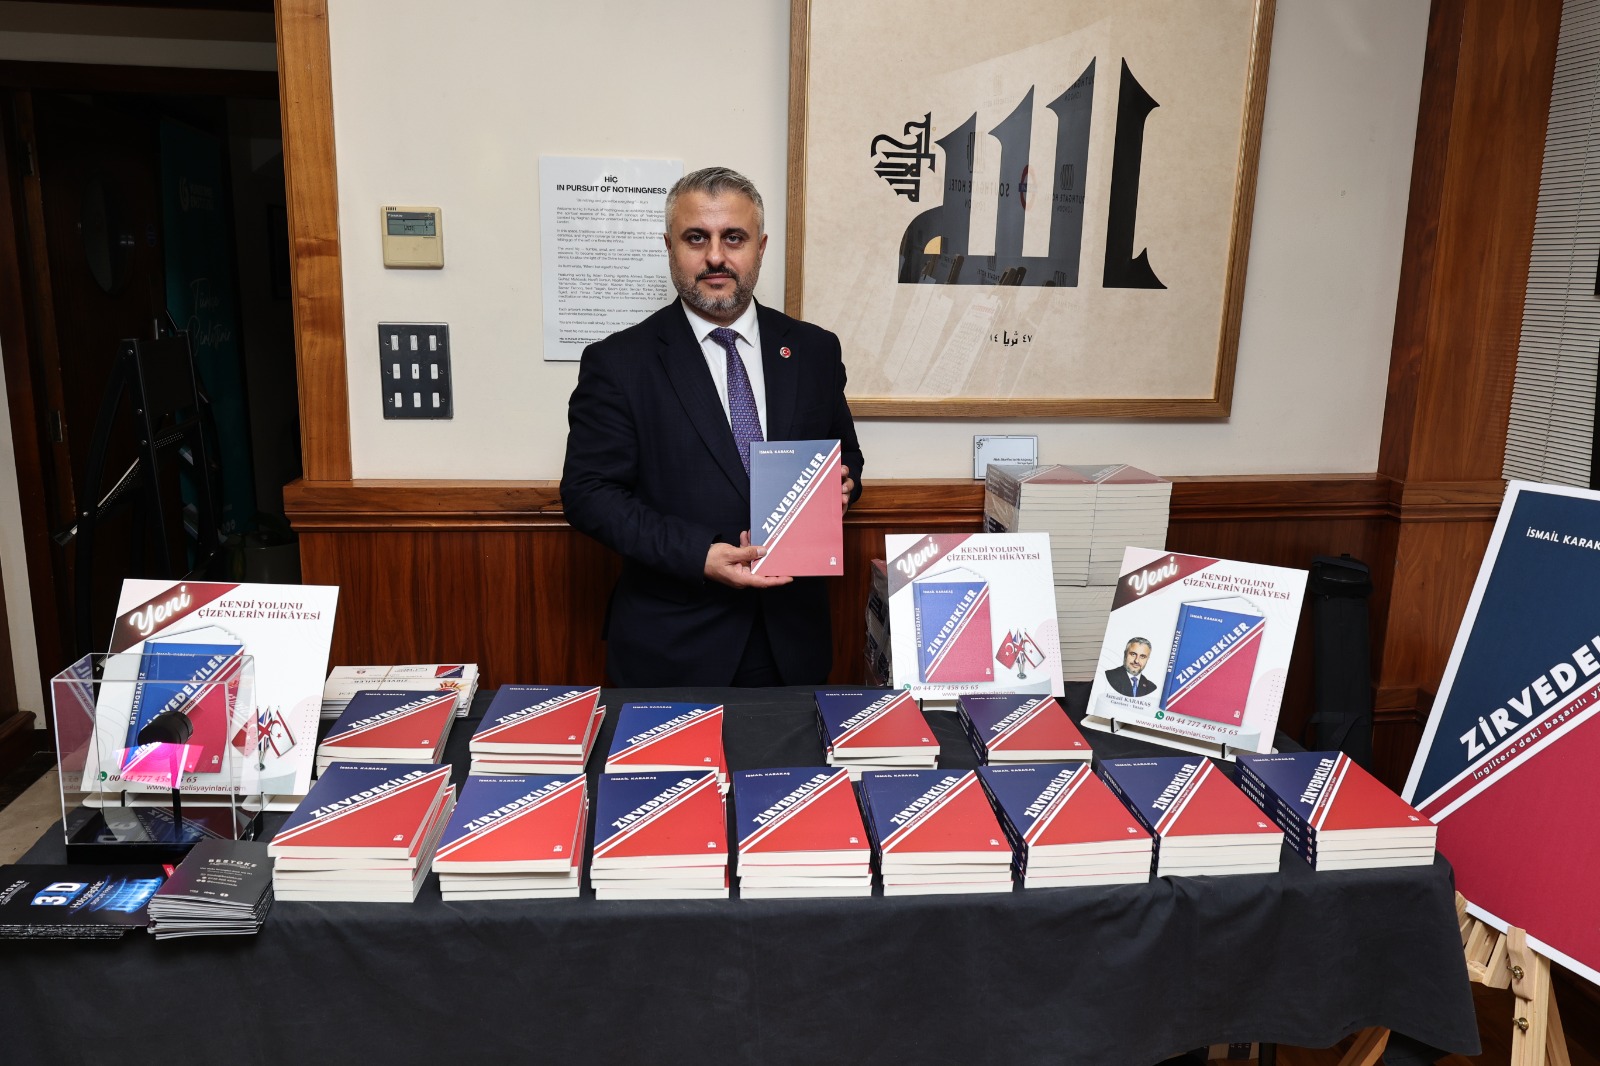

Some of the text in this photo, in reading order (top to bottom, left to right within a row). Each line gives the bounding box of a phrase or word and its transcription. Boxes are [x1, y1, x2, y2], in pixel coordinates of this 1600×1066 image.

[612, 186, 668, 194] NOTHINGNESS
[762, 452, 827, 535] ZİRVEDEKİLER
[961, 546, 988, 554] KENDİ
[1526, 526, 1560, 543] İSMAİL
[897, 537, 939, 578] Yeni
[946, 552, 1040, 562] ÇİZENLERİN HİKÂYESİ
[1128, 556, 1178, 596] Yeni
[1184, 578, 1290, 600] ÇİZENLERİN HİKÂYESİ
[1201, 572, 1275, 589] KENDİ YOLUNU
[129, 585, 191, 637] Yeni
[198, 609, 321, 620] ÇİZENLERİN HİKÂYESİ
[219, 600, 304, 610] KENDİ YOLUNU
[926, 589, 978, 656] ZİRVEDEKİLER
[1168, 630, 1181, 672] ZİRVEDEKİLER
[1176, 622, 1250, 685] ZİRVEDEKİLER
[348, 694, 440, 729] ZİRVEDEKİLER
[495, 690, 583, 724] ZİRVEDEKİLER
[839, 694, 896, 730] ZİRVEDEKİLER
[990, 698, 1041, 733] ZİRVEDEKİLER
[1187, 720, 1200, 728] 777
[1202, 723, 1216, 731] 458
[626, 708, 706, 745] ZİRVEDEKİLER
[1472, 728, 1542, 780] İngiltere'deki
[1544, 698, 1588, 730] başarılı
[136, 774, 152, 782] 777
[310, 770, 428, 819] ZİRVEDEKİLER
[1024, 769, 1075, 819] ZİRVEDEKİLER
[1152, 764, 1198, 811] ZİRVEDEKİLER
[1300, 758, 1335, 806] ZİRVEDEKİLER
[463, 780, 567, 831] ZİRVEDEKİLER
[612, 777, 698, 830] ZİRVEDEKİLER
[753, 774, 830, 825] ZİRVEDEKİLER
[890, 776, 959, 826] ZİRVEDEKİLER
[34, 882, 82, 906] 3D
